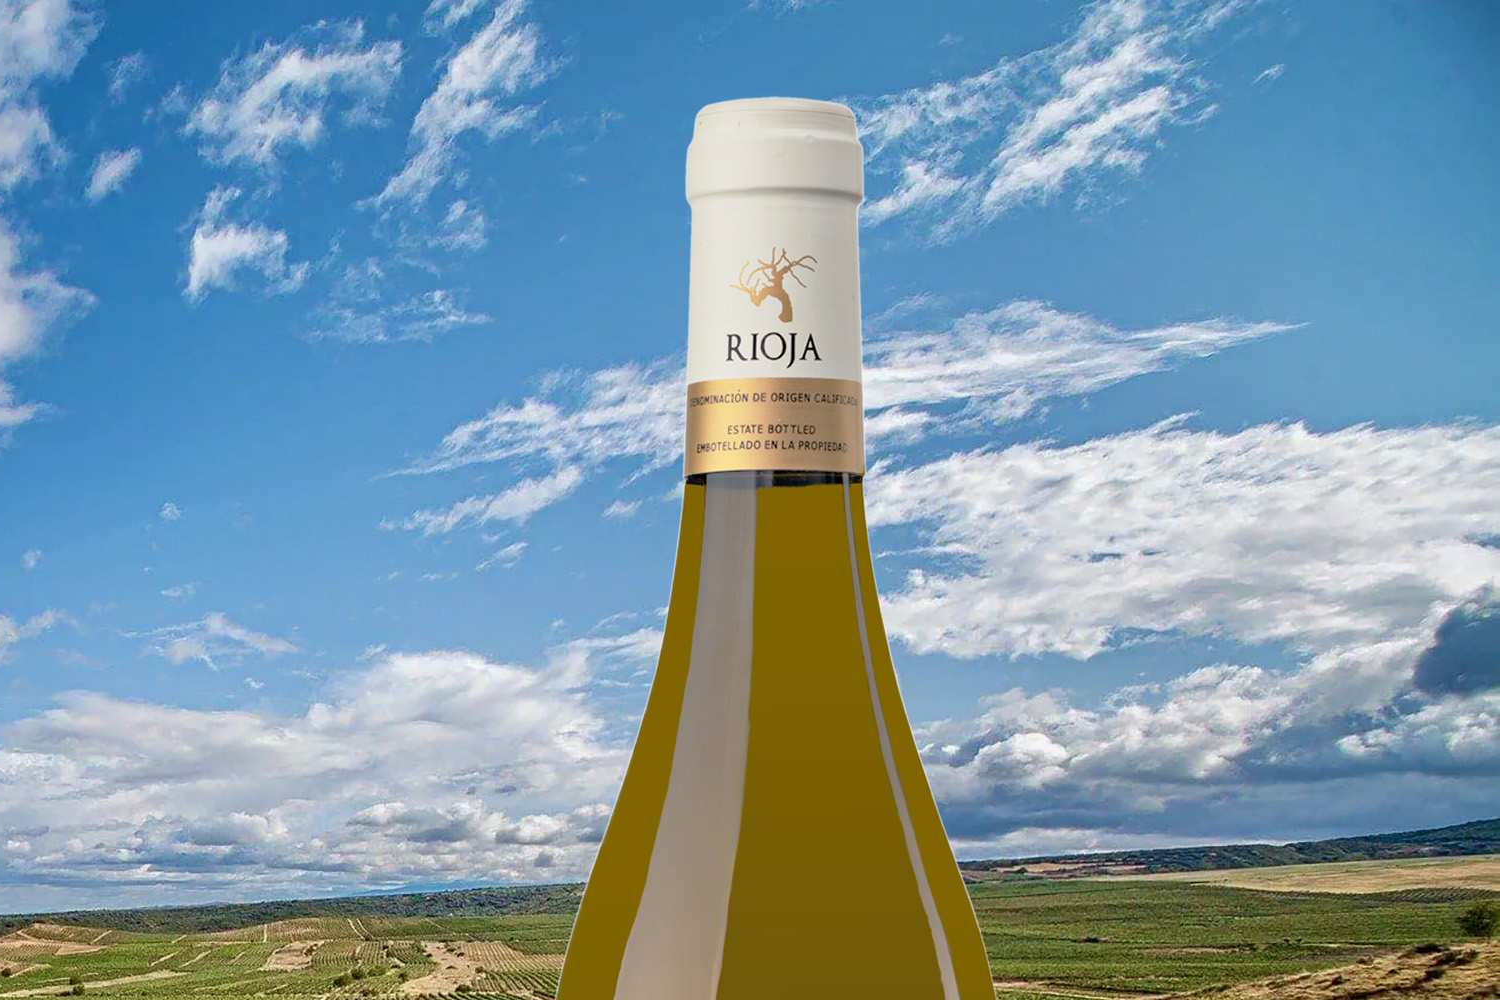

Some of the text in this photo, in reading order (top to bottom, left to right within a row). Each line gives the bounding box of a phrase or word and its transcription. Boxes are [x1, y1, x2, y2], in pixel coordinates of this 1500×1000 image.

[725, 332, 822, 369] RIOJA
[752, 392, 767, 403] DE
[770, 392, 811, 403] ORIGEN
[727, 424, 817, 435] ESTATE BOTTLED
[696, 441, 761, 454] EMBOTELLADO
[764, 440, 778, 450] EN
[781, 441, 796, 450] LA
